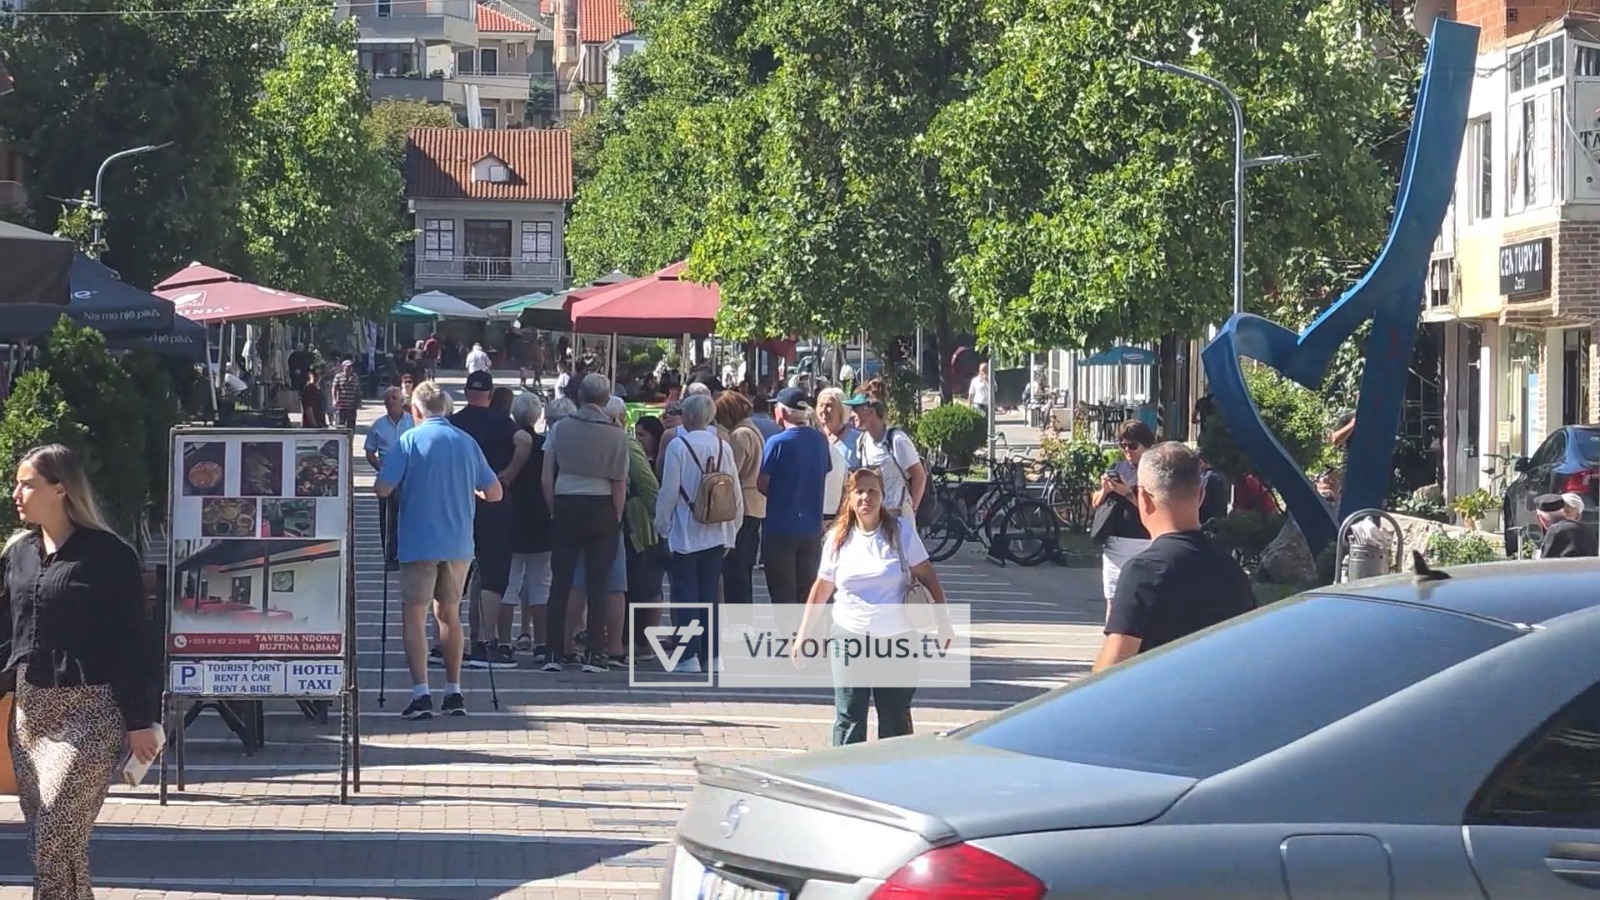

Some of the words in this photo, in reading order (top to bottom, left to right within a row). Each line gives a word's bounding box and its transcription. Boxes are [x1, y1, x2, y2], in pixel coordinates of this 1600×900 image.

[1500, 244, 1533, 276] CENTURY
[1534, 243, 1542, 271] 21
[255, 634, 300, 642] TAVERNA
[301, 634, 337, 642] NDONA
[259, 643, 300, 651] BUJTINA
[302, 643, 339, 651] DARIAN
[208, 664, 249, 672] TOURIST
[251, 664, 281, 672] POINT
[293, 665, 342, 675] HOTEL
[181, 666, 196, 685] P
[214, 674, 239, 682] RENT
[241, 674, 249, 682] A
[251, 674, 271, 682] CAR
[213, 685, 237, 693] RENT
[240, 685, 247, 693] A
[250, 685, 272, 693] BIKE
[298, 680, 332, 690] TAXI
